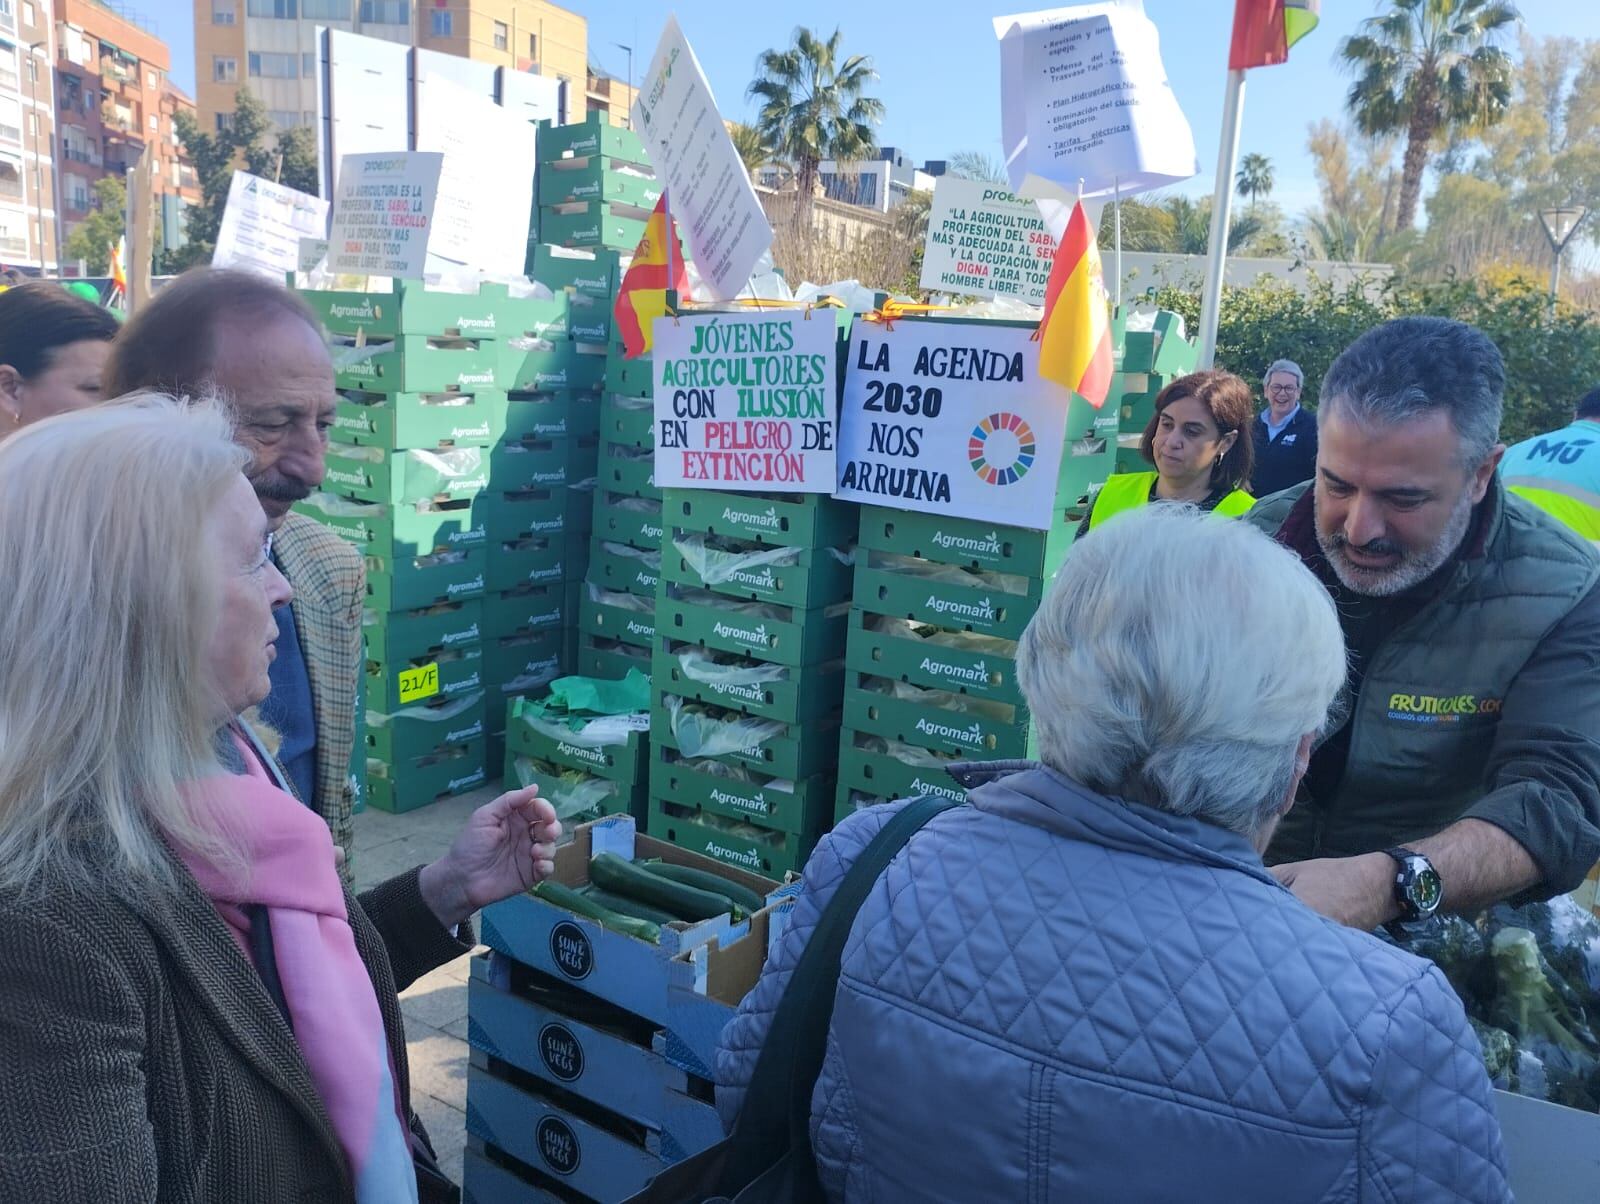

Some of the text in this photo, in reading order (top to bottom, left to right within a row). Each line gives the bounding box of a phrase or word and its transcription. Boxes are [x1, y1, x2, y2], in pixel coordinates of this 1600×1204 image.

[1050, 61, 1083, 74] Defensa
[1091, 52, 1104, 62] del
[1051, 69, 1085, 83] Trasvase
[1052, 96, 1070, 109] Plan
[1053, 105, 1098, 124] Eliminación
[1100, 100, 1113, 111] del
[1054, 124, 1131, 150] Tarifas eléctricas
[1054, 147, 1072, 158] para
[412, 185, 422, 197] LA
[971, 210, 1044, 231] AGRICULTURA
[959, 235, 1014, 253] ADECUADA
[1019, 244, 1031, 257] AL
[1005, 229, 1024, 241] DEL
[951, 248, 956, 259] Y
[961, 249, 973, 261] LA
[941, 272, 984, 289] HOMBRE
[957, 262, 1050, 285] DIGNA PARA TOD
[330, 303, 374, 319] Agromark
[457, 316, 496, 328] Agromark
[690, 318, 793, 355] JÓVENES
[662, 355, 826, 387] AGRICULTORES
[858, 340, 1024, 382] LA AGENDA
[458, 372, 494, 384] Agromark
[673, 384, 826, 418] CON ILUSIÓN
[863, 380, 943, 418] 2030
[451, 426, 490, 437] Agromark
[660, 420, 833, 451] EN PELIGRO DE
[868, 423, 923, 458] NOS
[326, 467, 368, 486] Agromark
[682, 447, 805, 483] EXTINCIÓN
[448, 478, 488, 490] Agromark
[841, 461, 951, 503] ARRUINA
[722, 506, 780, 529] Agromark
[641, 523, 663, 537] Agro
[932, 530, 1000, 554] Agromark
[448, 579, 485, 593] Agromark
[636, 571, 657, 586] Agro
[925, 595, 994, 620] Agromark
[442, 627, 480, 643] Agromark
[713, 621, 768, 645] Agromark
[401, 670, 437, 693] 21/F
[920, 657, 988, 683] Agromark
[709, 682, 764, 702] Agromark
[916, 717, 983, 745] Agromark
[557, 741, 606, 764] Agromark
[710, 788, 767, 813] Agromark
[910, 777, 968, 804] Agromar
[706, 840, 760, 868] Agromark
